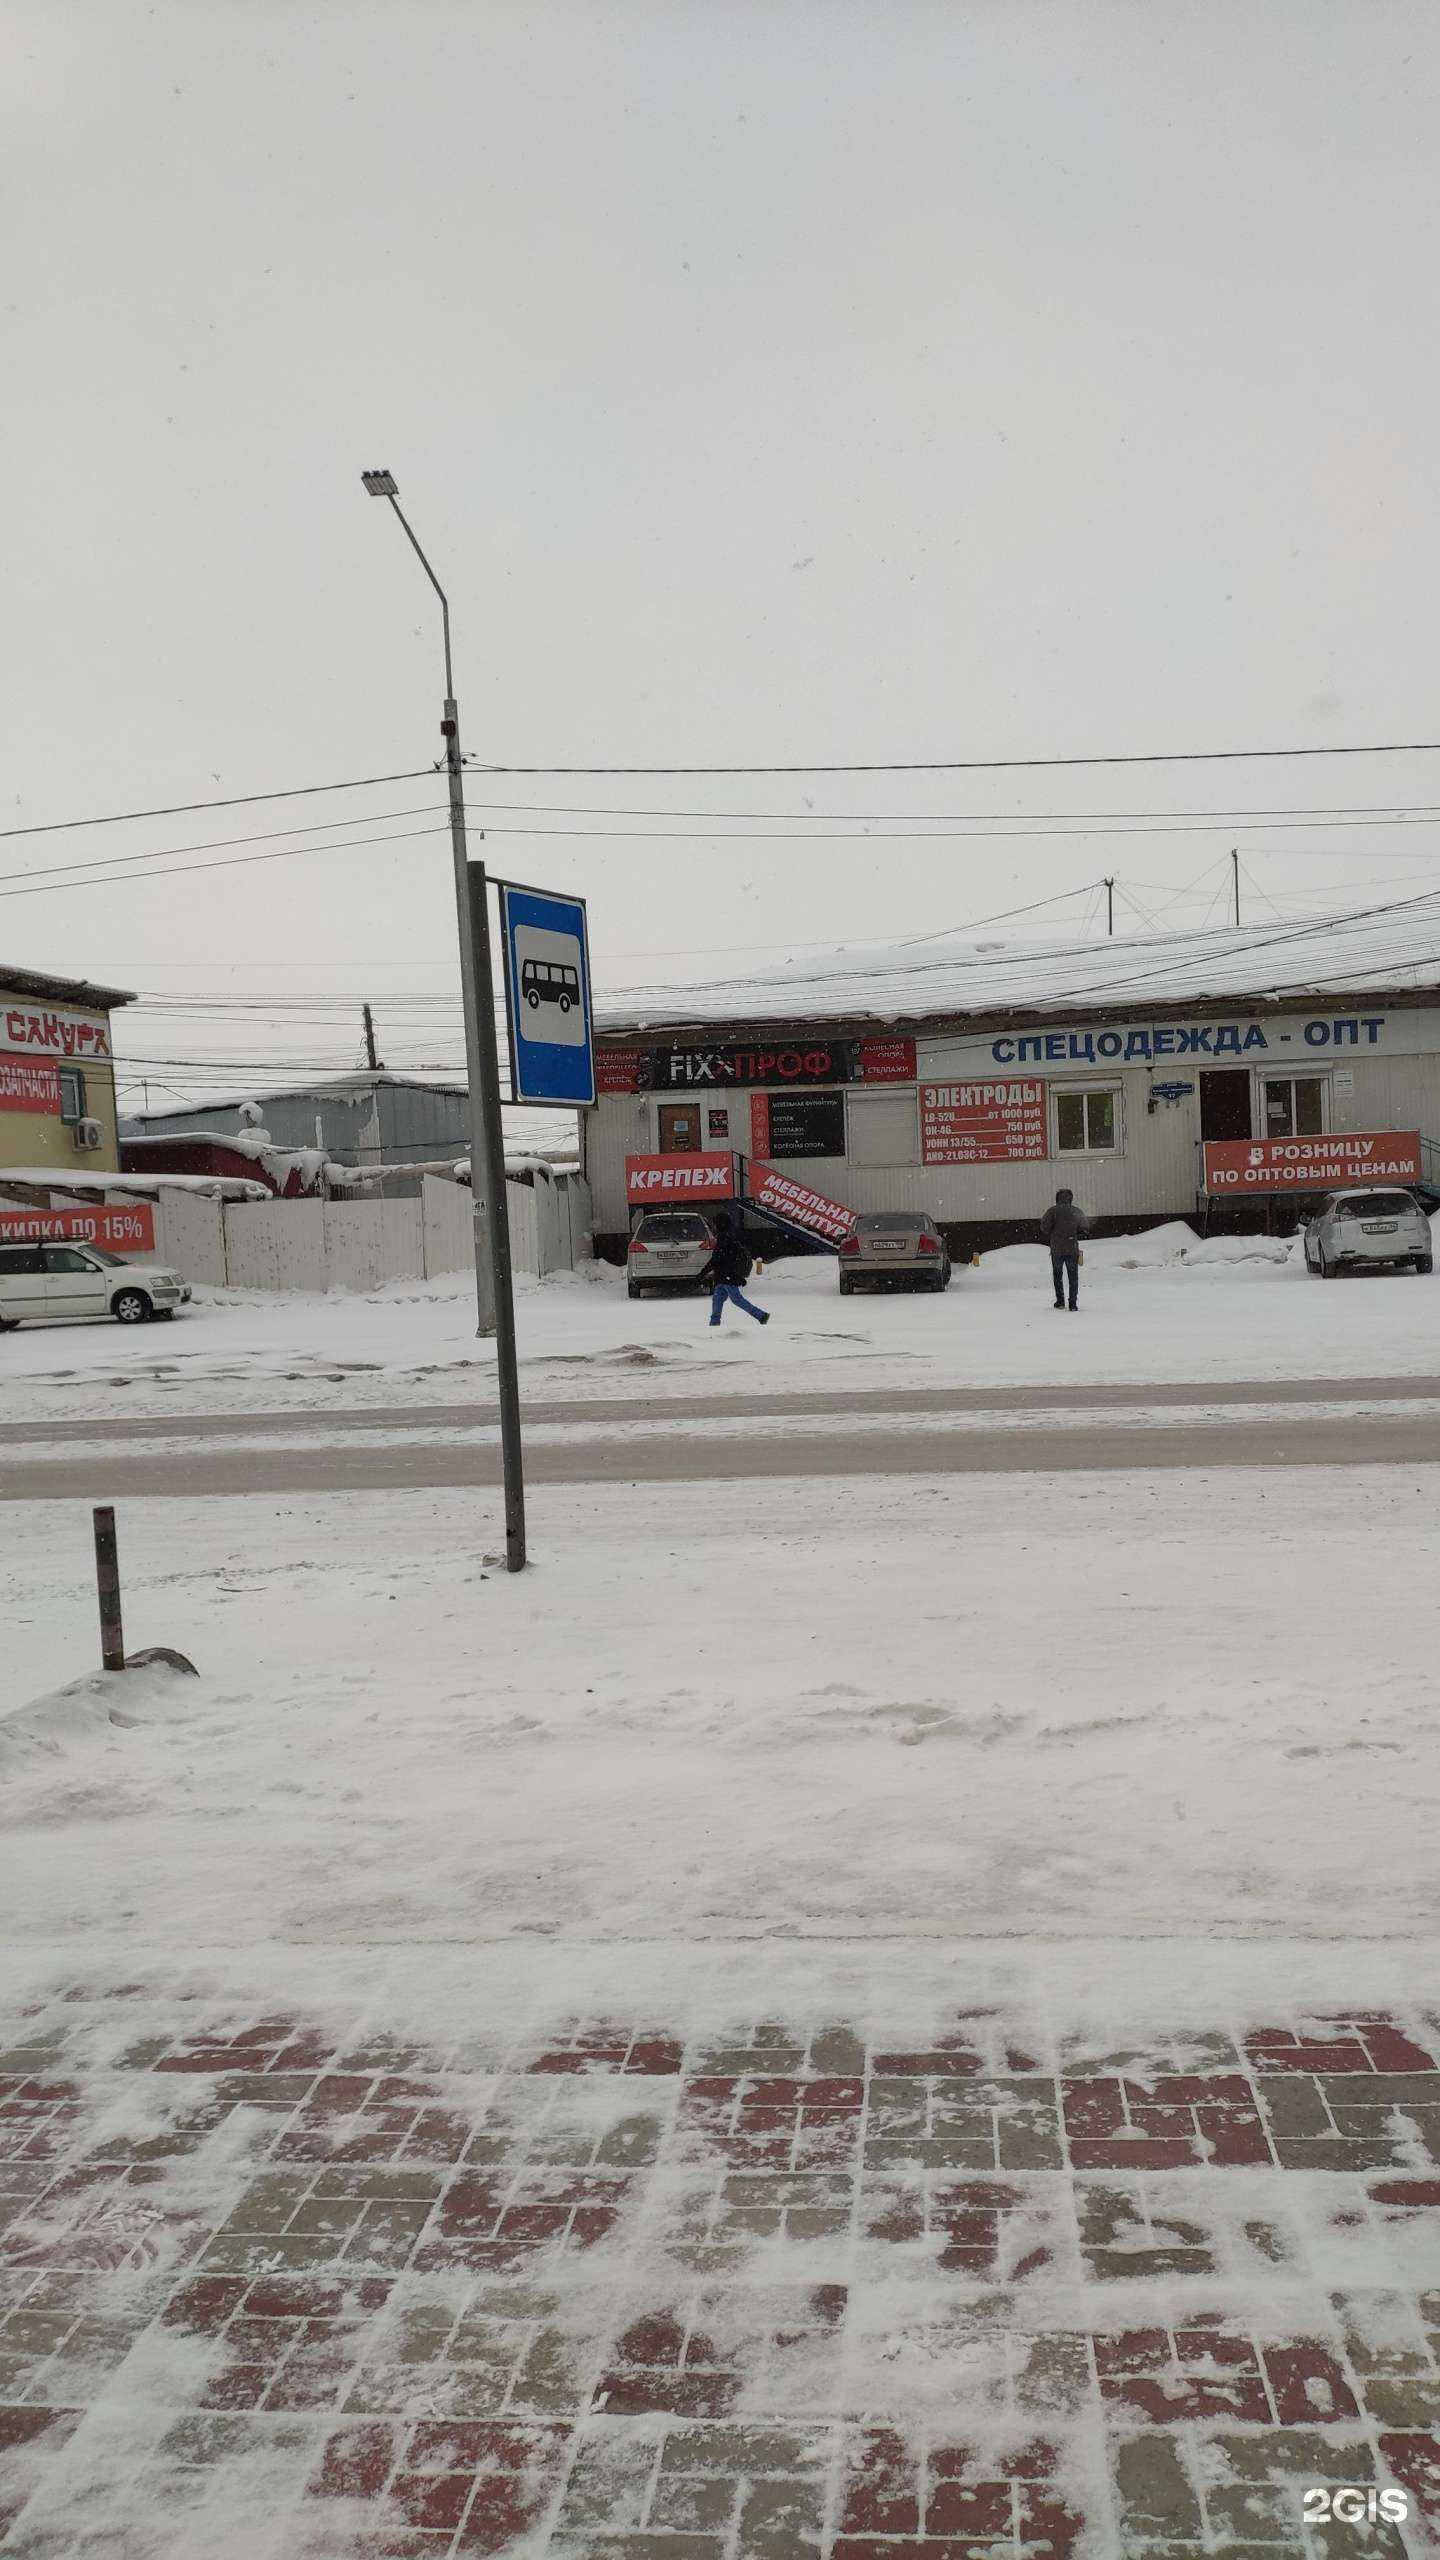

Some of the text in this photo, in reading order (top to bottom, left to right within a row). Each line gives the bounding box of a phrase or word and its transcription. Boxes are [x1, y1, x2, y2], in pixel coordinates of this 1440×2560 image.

[7, 1011, 110, 1055] САКУРА
[992, 1025, 1268, 1063] СПЕЦОДЕЖДА
[1304, 1019, 1385, 1047] ОПТ
[735, 1051, 831, 1081] ПРОФ
[867, 1065, 909, 1075] СТЕЛЛАЖИ
[925, 1083, 1042, 1108] ЭЛЕКТРОДЫ
[1001, 1109, 1023, 1119] 1000
[1024, 1107, 1043, 1119] руб.
[1006, 1122, 1023, 1132] 750
[1024, 1120, 1044, 1133] руб.
[950, 1136, 976, 1148] 13/55
[1005, 1135, 1024, 1145] 650
[1025, 1134, 1045, 1147] руб.
[1007, 1148, 1025, 1158] 700
[1025, 1146, 1045, 1159] руб.
[1250, 1141, 1374, 1163] В РОЗНИЦУ
[630, 1167, 729, 1189] КРЕПЕЖ
[1212, 1160, 1414, 1184] ПО ОПТОВЫМ ЦЕНАМ
[760, 1190, 848, 1237] ФУРНИТУР
[0, 1215, 144, 1241] КИДКА ПО 15%
